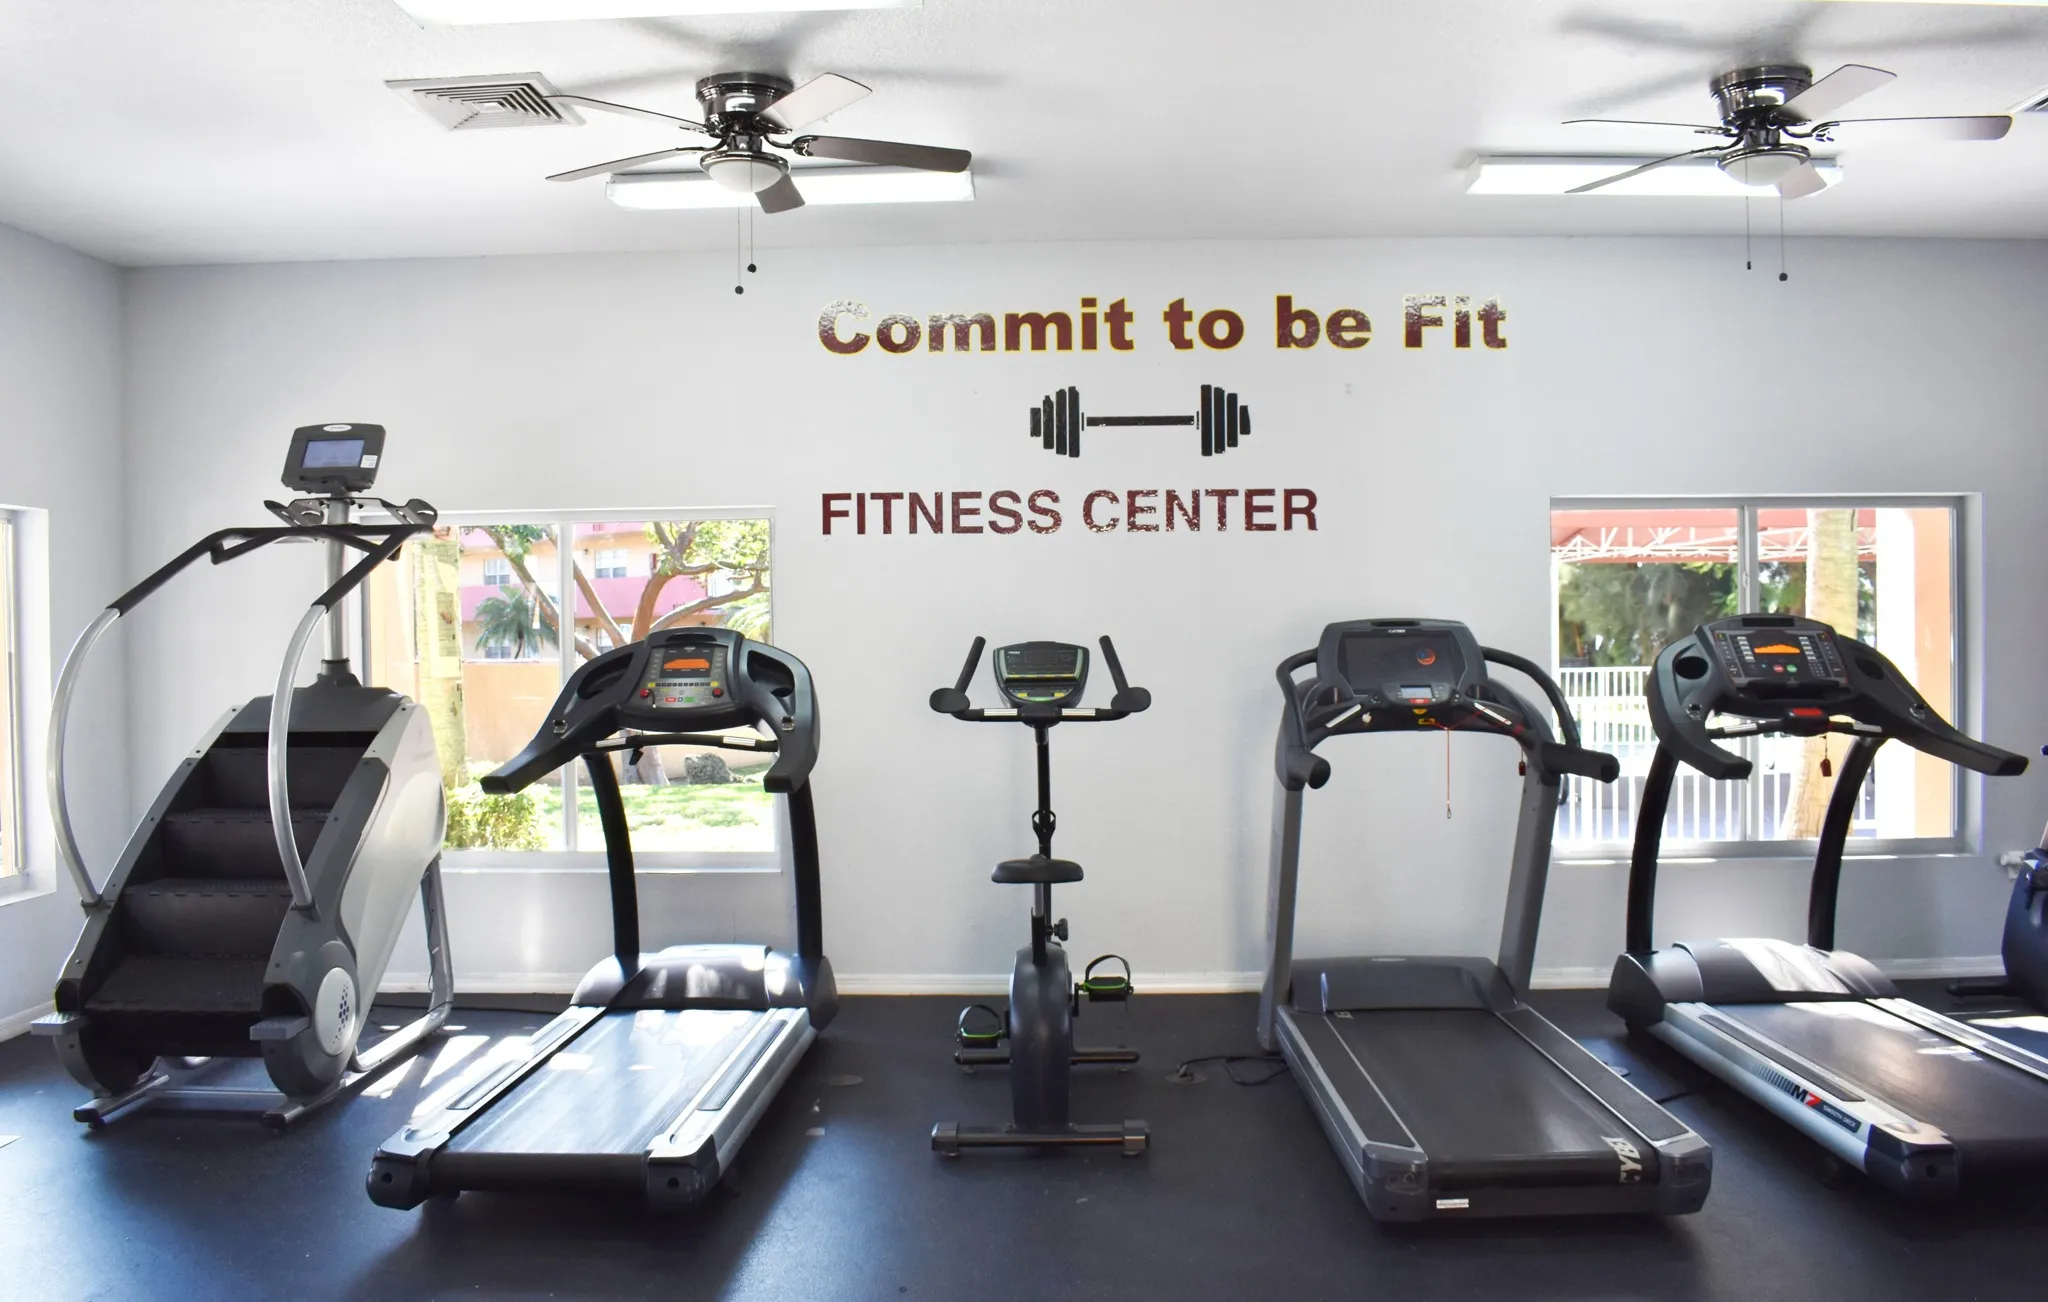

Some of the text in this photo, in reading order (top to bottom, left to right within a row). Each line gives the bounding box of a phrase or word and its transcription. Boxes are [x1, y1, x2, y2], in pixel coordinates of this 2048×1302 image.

[818, 294, 1508, 355] Commit to be Fit
[821, 488, 1317, 537] FITNESS CENTER
[1791, 1084, 1822, 1108] M7
